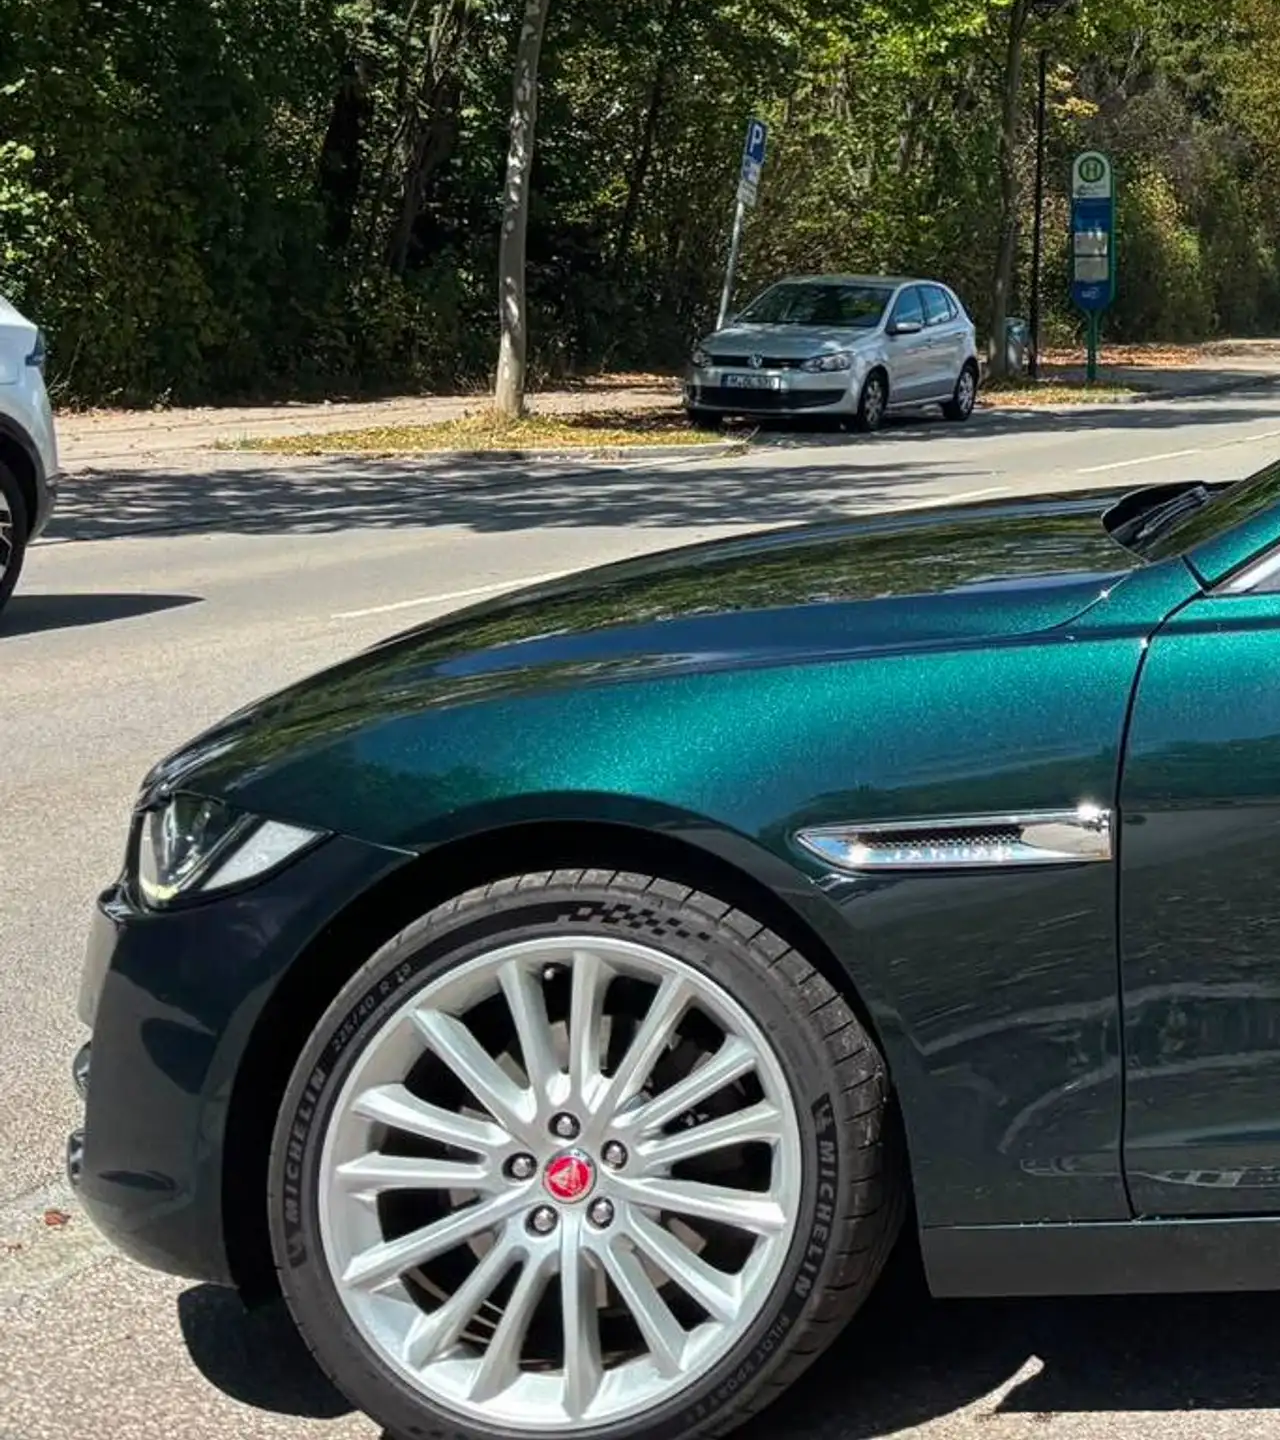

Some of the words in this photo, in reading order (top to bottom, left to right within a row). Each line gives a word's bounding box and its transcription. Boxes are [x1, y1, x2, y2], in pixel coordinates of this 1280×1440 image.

[749, 123, 763, 153] P
[284, 1069, 327, 1225] MICHELIN
[793, 1140, 837, 1299] MICHELIN
